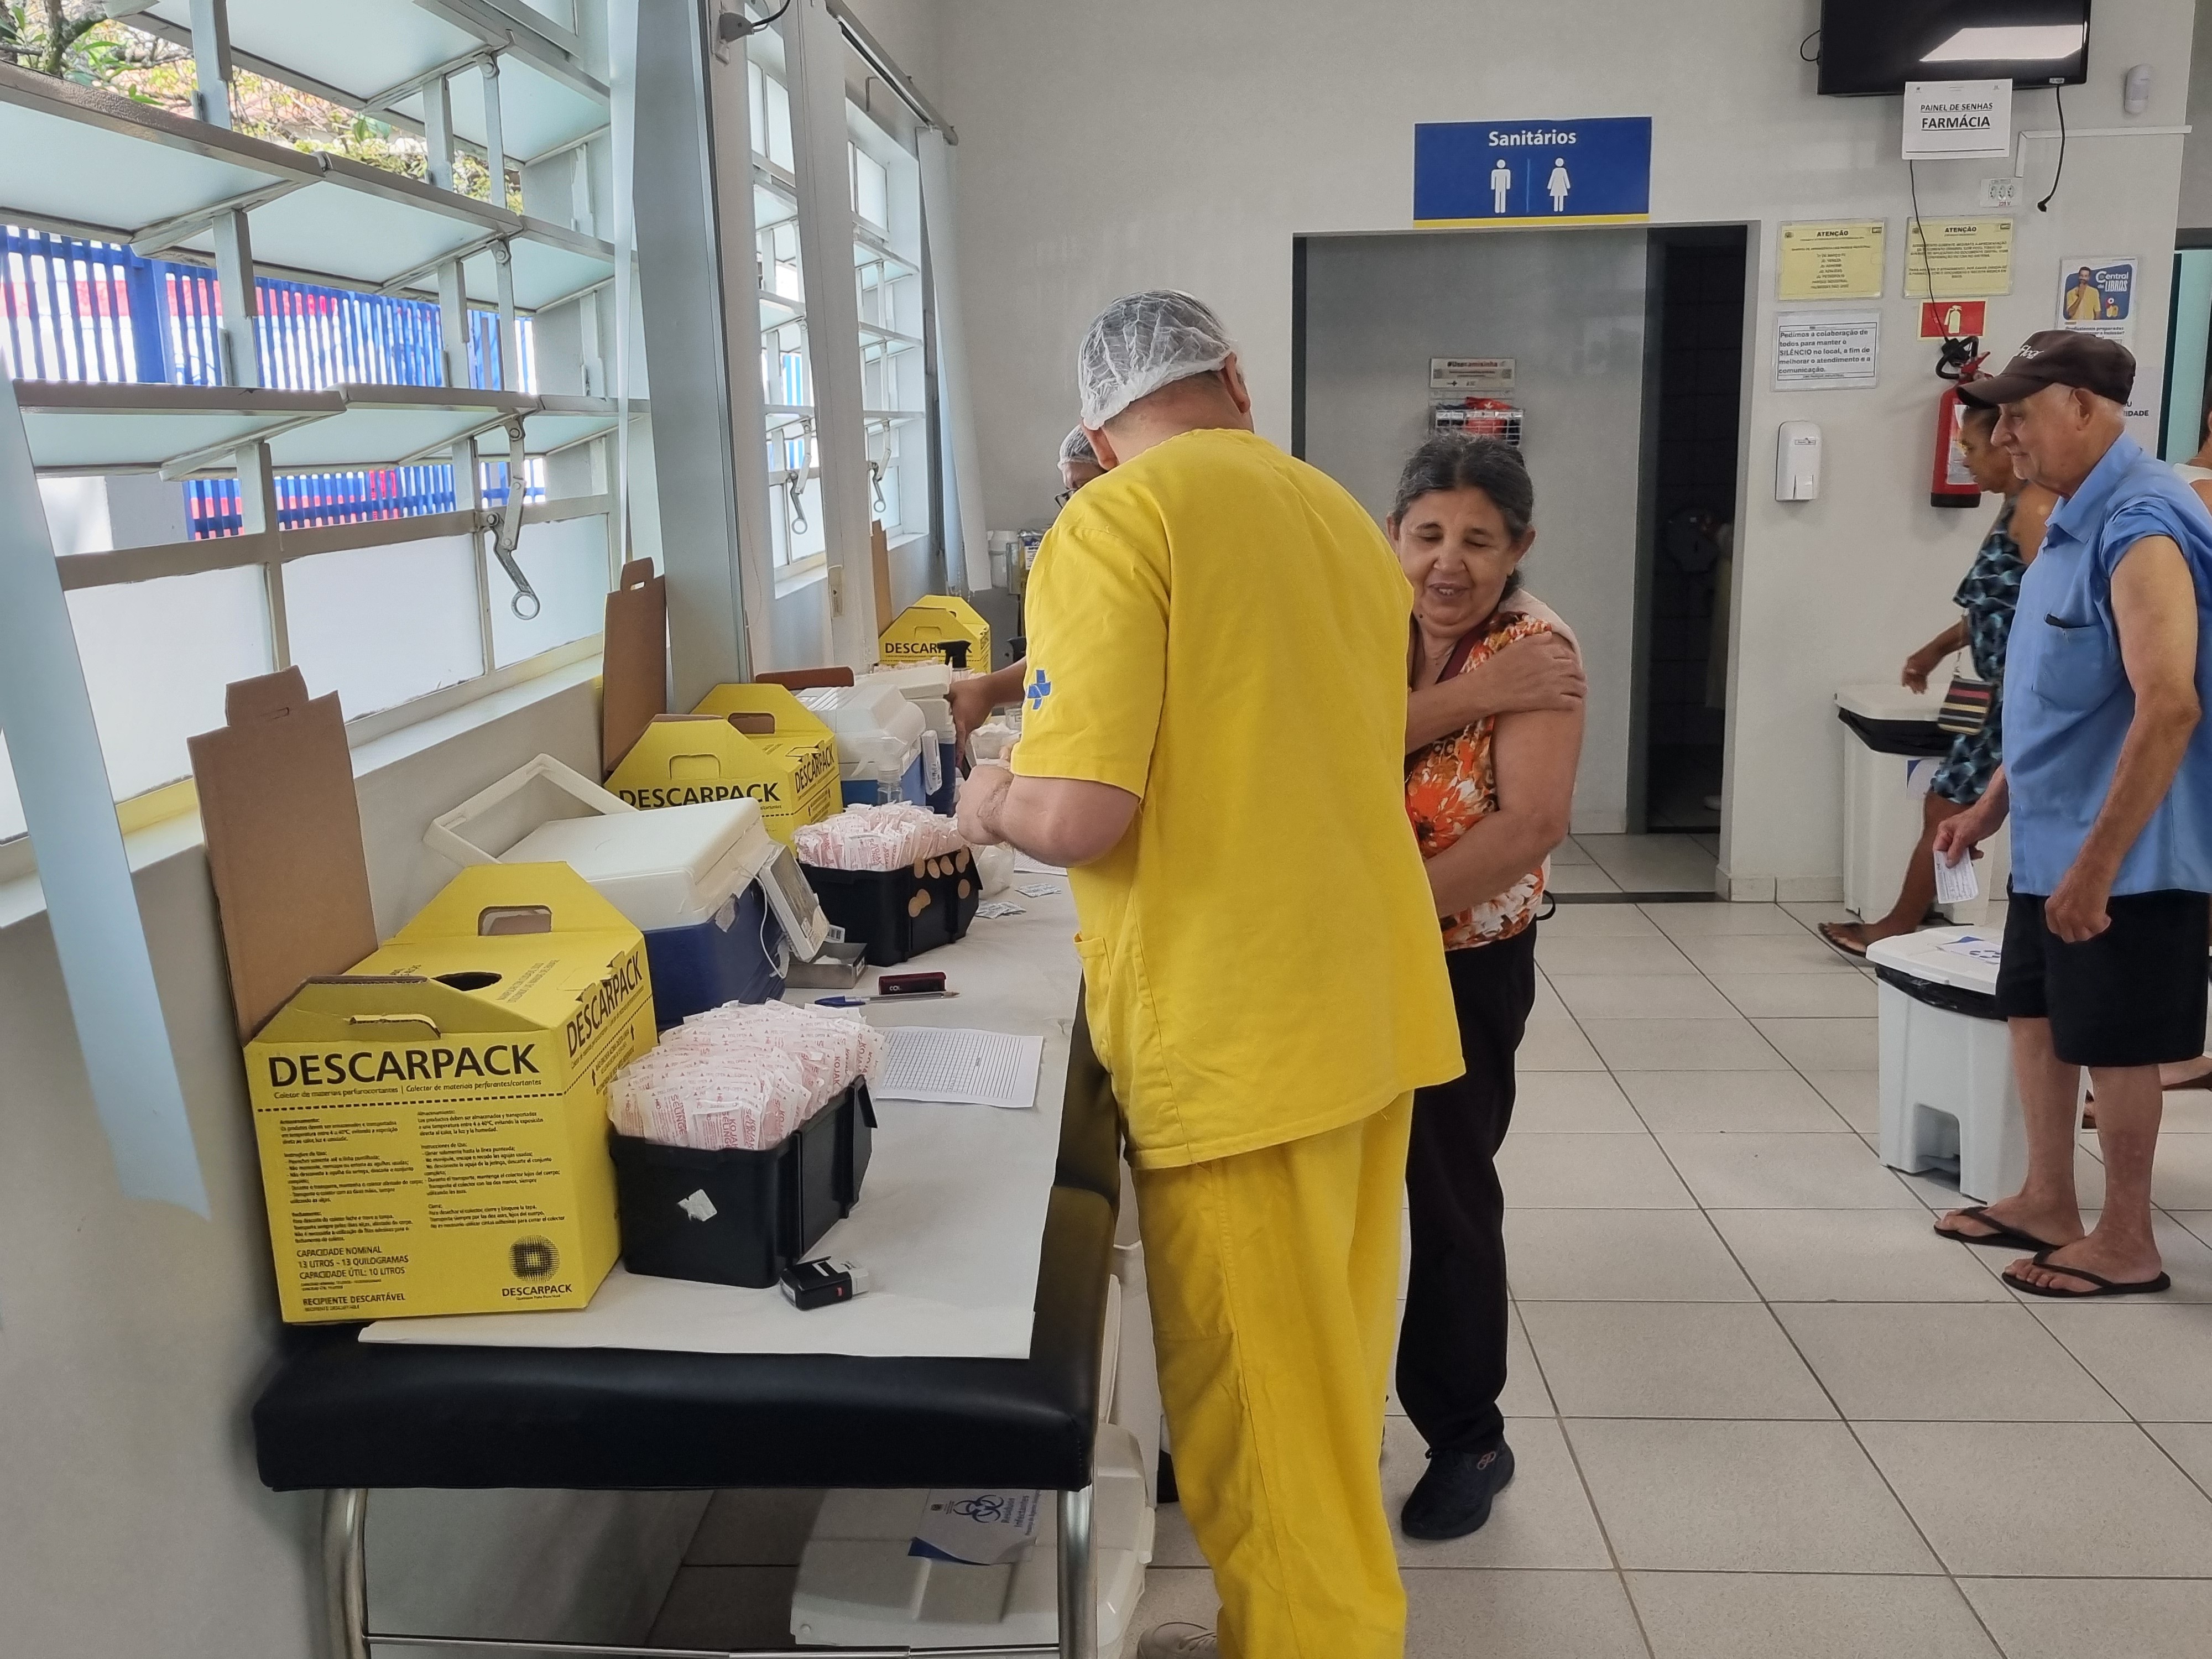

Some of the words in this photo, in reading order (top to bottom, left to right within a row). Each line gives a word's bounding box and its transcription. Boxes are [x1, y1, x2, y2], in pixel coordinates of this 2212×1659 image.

[1922, 114, 1990, 128] FARMÁCIA
[1489, 129, 1576, 146] Sanitários
[2095, 271, 2128, 283] Central
[795, 743, 834, 794] DESCARPACK
[566, 951, 643, 1058] DESCARPACK
[269, 1044, 540, 1087] DESCARPACK
[406, 1084, 432, 1092] Colector
[296, 1247, 344, 1257] CAPACIDADE
[346, 1246, 382, 1255] NOMINAL
[309, 1259, 334, 1267] LITROS
[353, 1255, 409, 1265] QUILOGRAMAS
[299, 1270, 347, 1279] CAPACIDADE
[348, 1267, 368, 1277] ÚTIL:
[380, 1266, 405, 1275] LITROS
[502, 1284, 572, 1297] DESCARPACK
[303, 1296, 348, 1305] RECIPIENTE
[350, 1292, 405, 1303] DESCARTÁVEL
